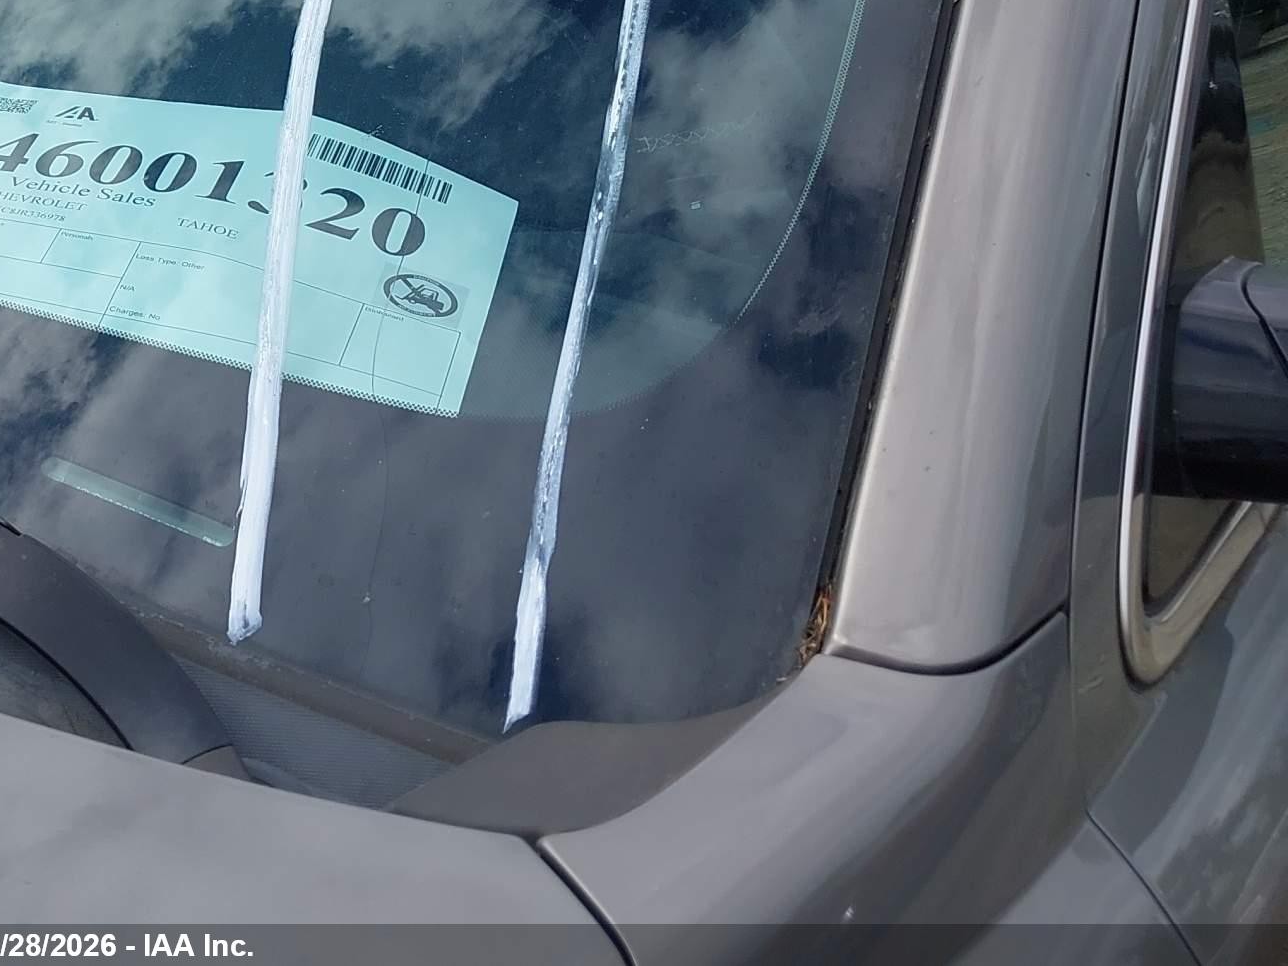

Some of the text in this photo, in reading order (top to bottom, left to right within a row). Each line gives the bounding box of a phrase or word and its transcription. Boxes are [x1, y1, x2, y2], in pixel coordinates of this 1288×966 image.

[12, 176, 91, 197] Vehicle
[96, 188, 157, 207] Sales
[177, 217, 240, 239] TAHOE
[135, 253, 155, 262] Loss
[181, 261, 205, 270] Other
[119, 284, 135, 292] N/A
[109, 305, 161, 321] Charges: No
